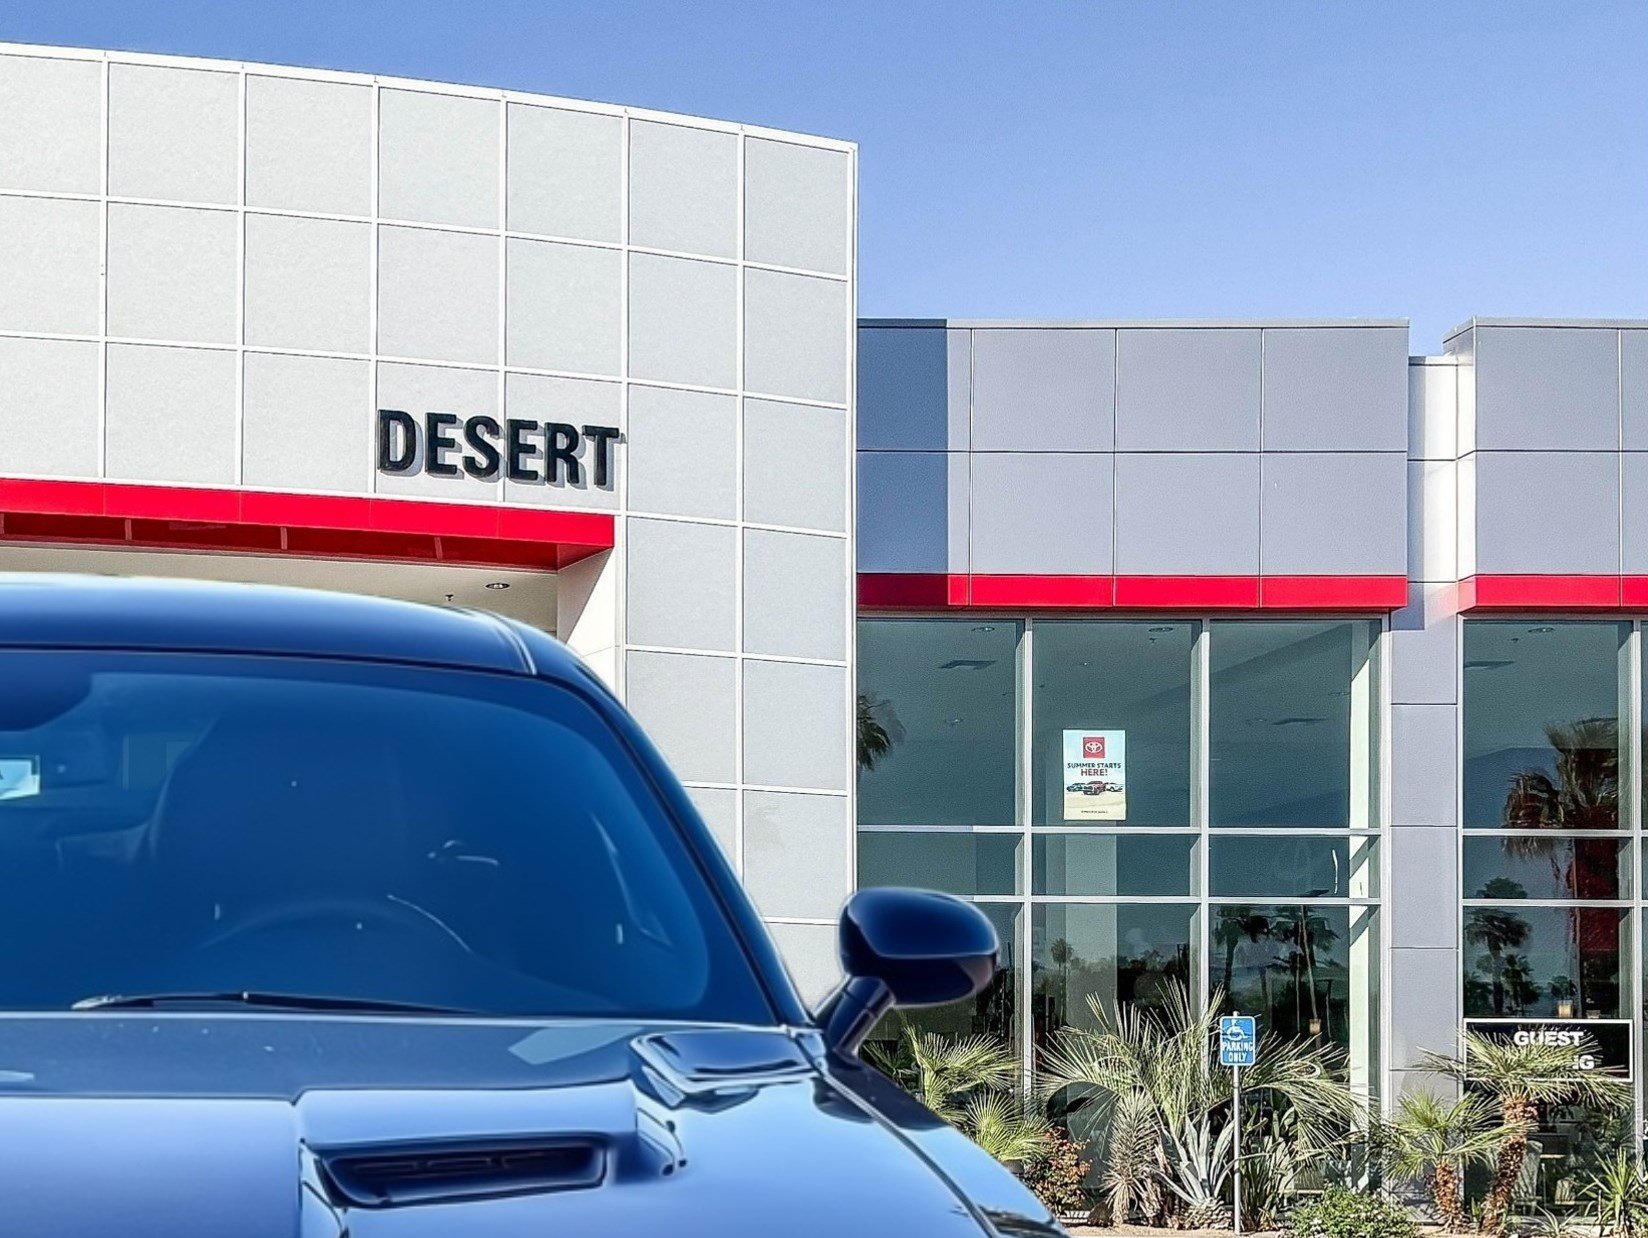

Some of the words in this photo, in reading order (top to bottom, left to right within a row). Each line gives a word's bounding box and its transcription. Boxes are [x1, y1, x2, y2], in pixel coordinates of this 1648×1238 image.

[377, 409, 619, 486] DESERT
[1514, 1031, 1584, 1046] GUEST
[1222, 1041, 1253, 1051] PARKING
[1228, 1052, 1247, 1062] ONLY
